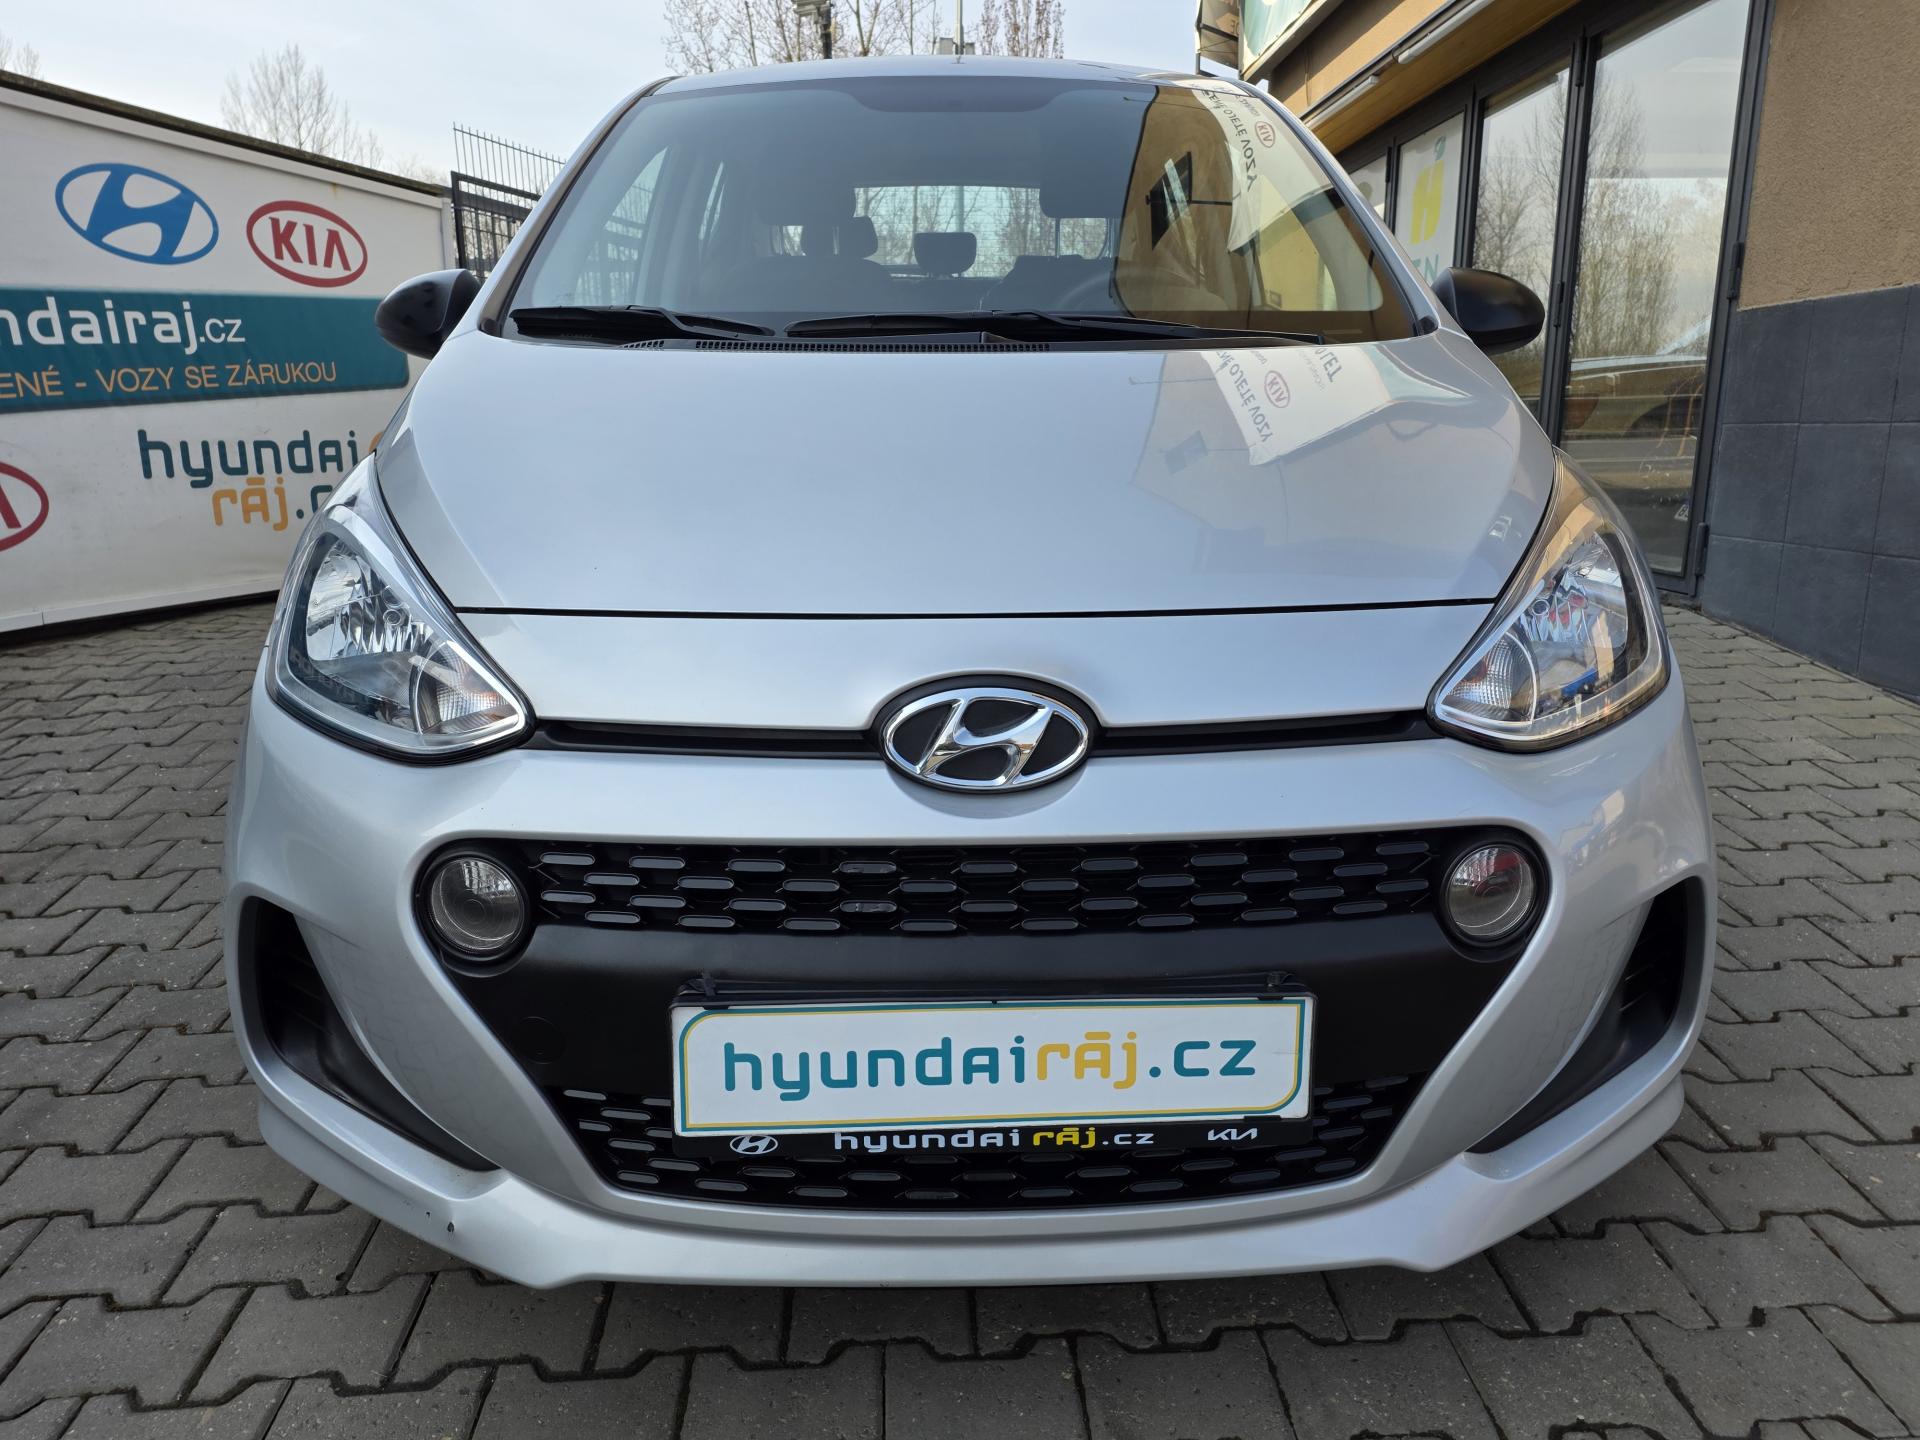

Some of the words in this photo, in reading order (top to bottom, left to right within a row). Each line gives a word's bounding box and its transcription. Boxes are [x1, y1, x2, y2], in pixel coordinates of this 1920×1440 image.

[268, 215, 353, 272] KIA
[96, 367, 174, 393] VOZY
[184, 365, 219, 388] SE
[225, 359, 337, 387] ZÁRUKOU
[834, 1128, 1021, 1153] hyundai
